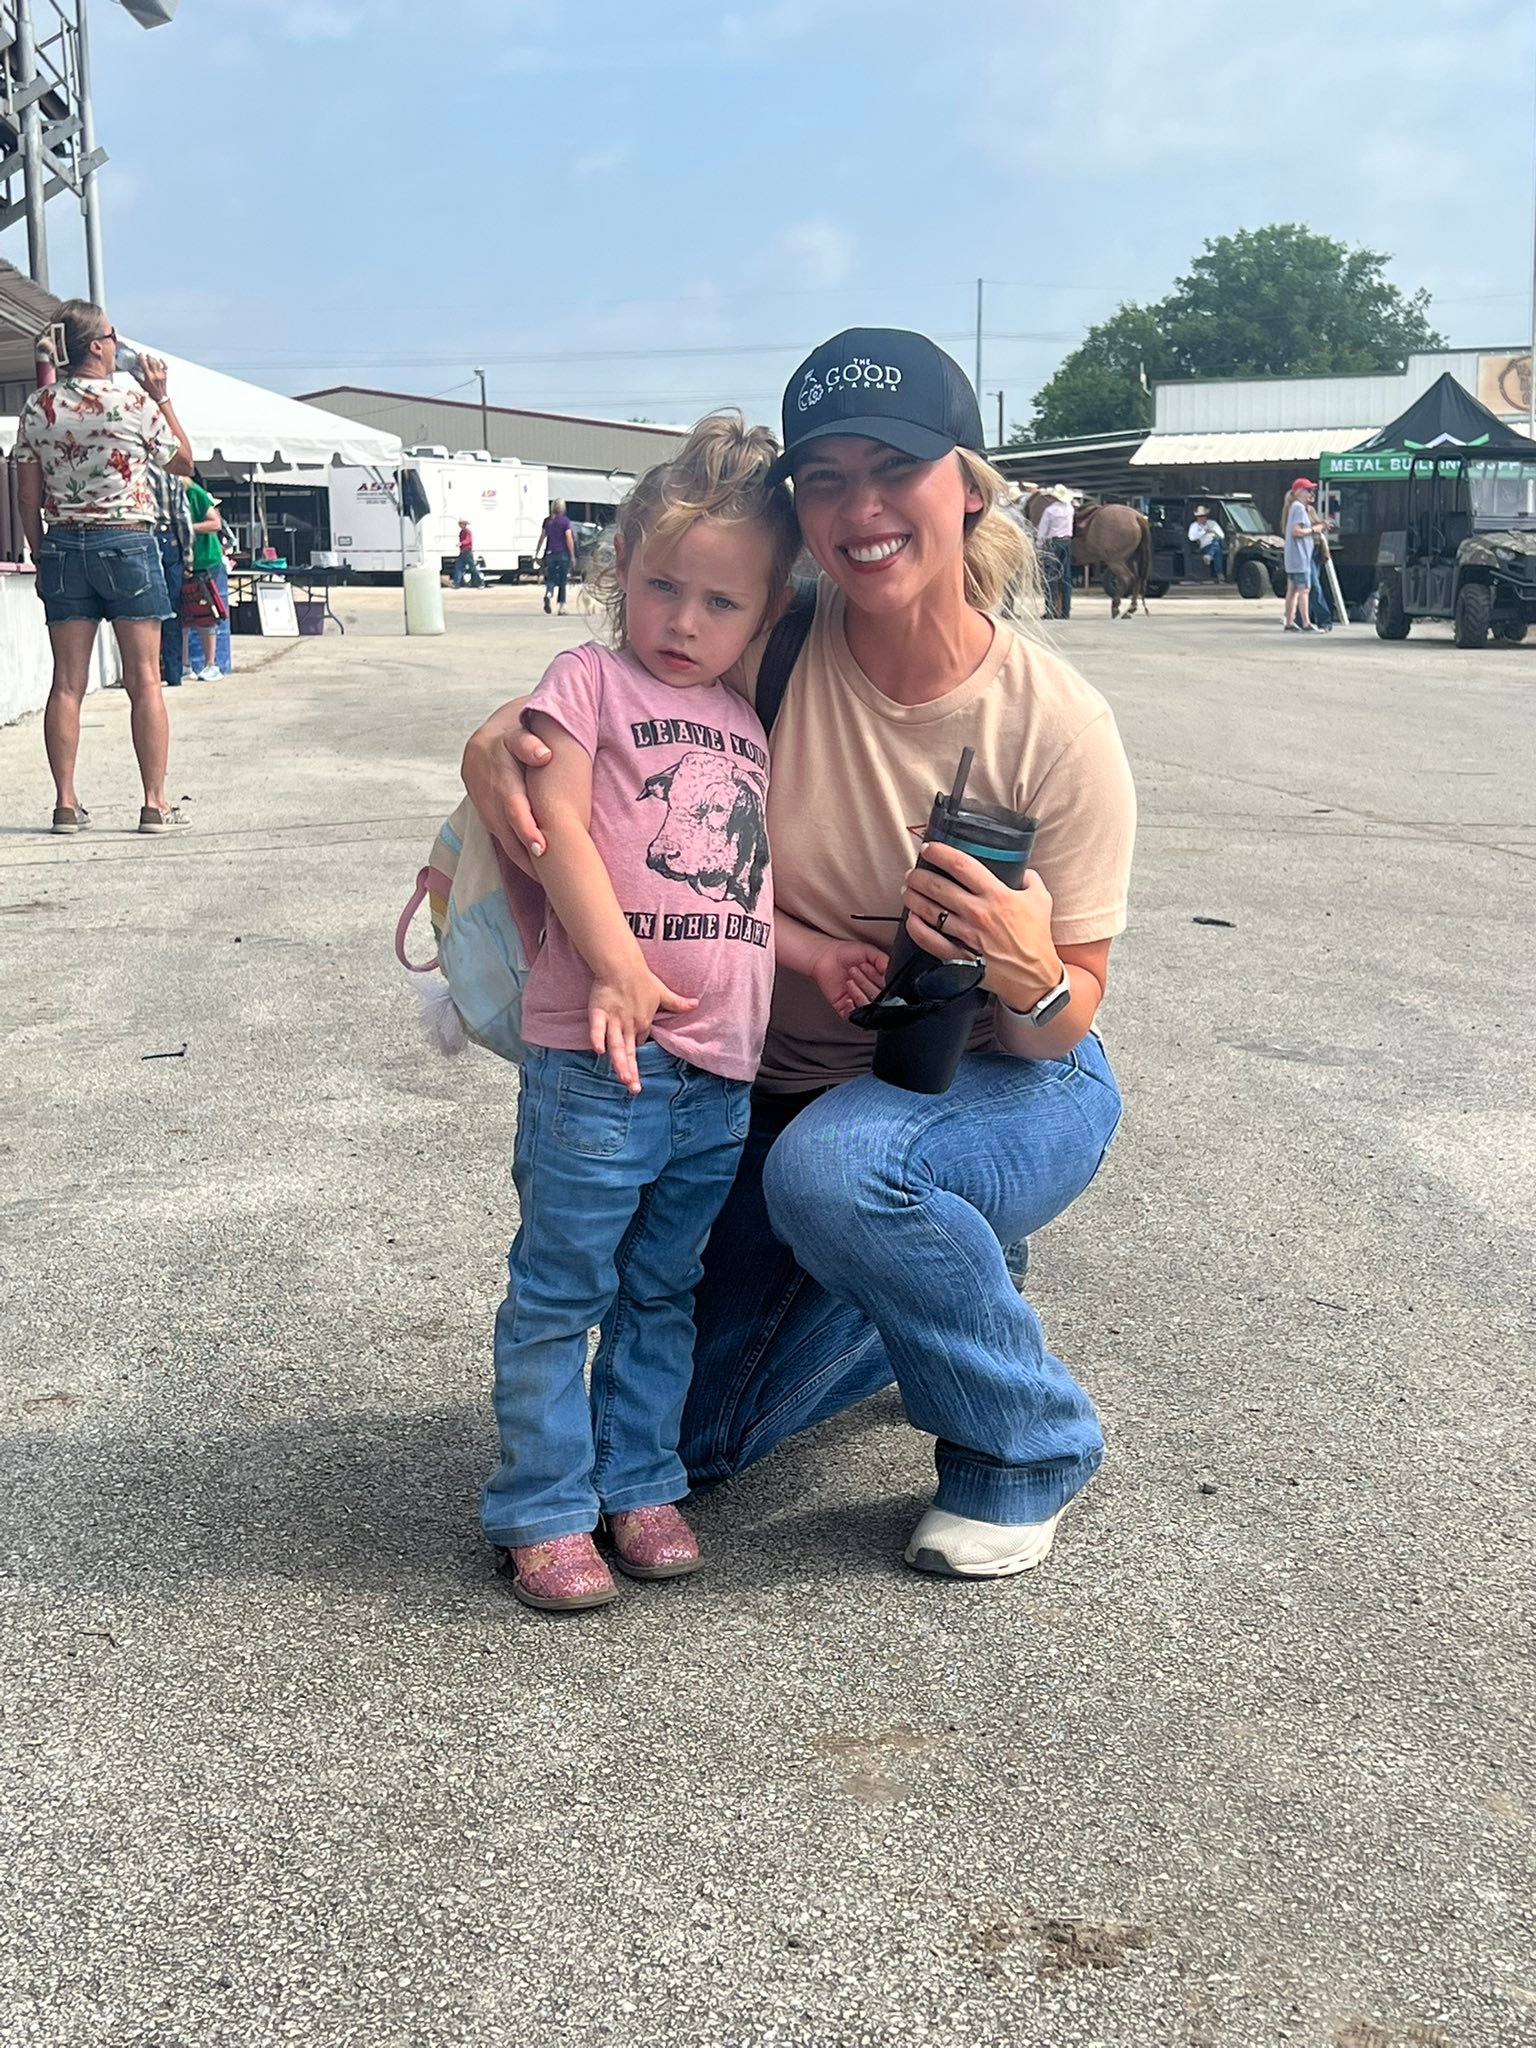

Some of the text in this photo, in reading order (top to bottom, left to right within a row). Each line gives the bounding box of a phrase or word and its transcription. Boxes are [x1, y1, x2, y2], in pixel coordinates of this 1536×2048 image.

[852, 357, 871, 366] THE
[825, 364, 902, 386] GOOD
[1330, 459, 1384, 472] METAL
[631, 719, 768, 770] LEAVE YOU
[663, 914, 719, 940] THE
